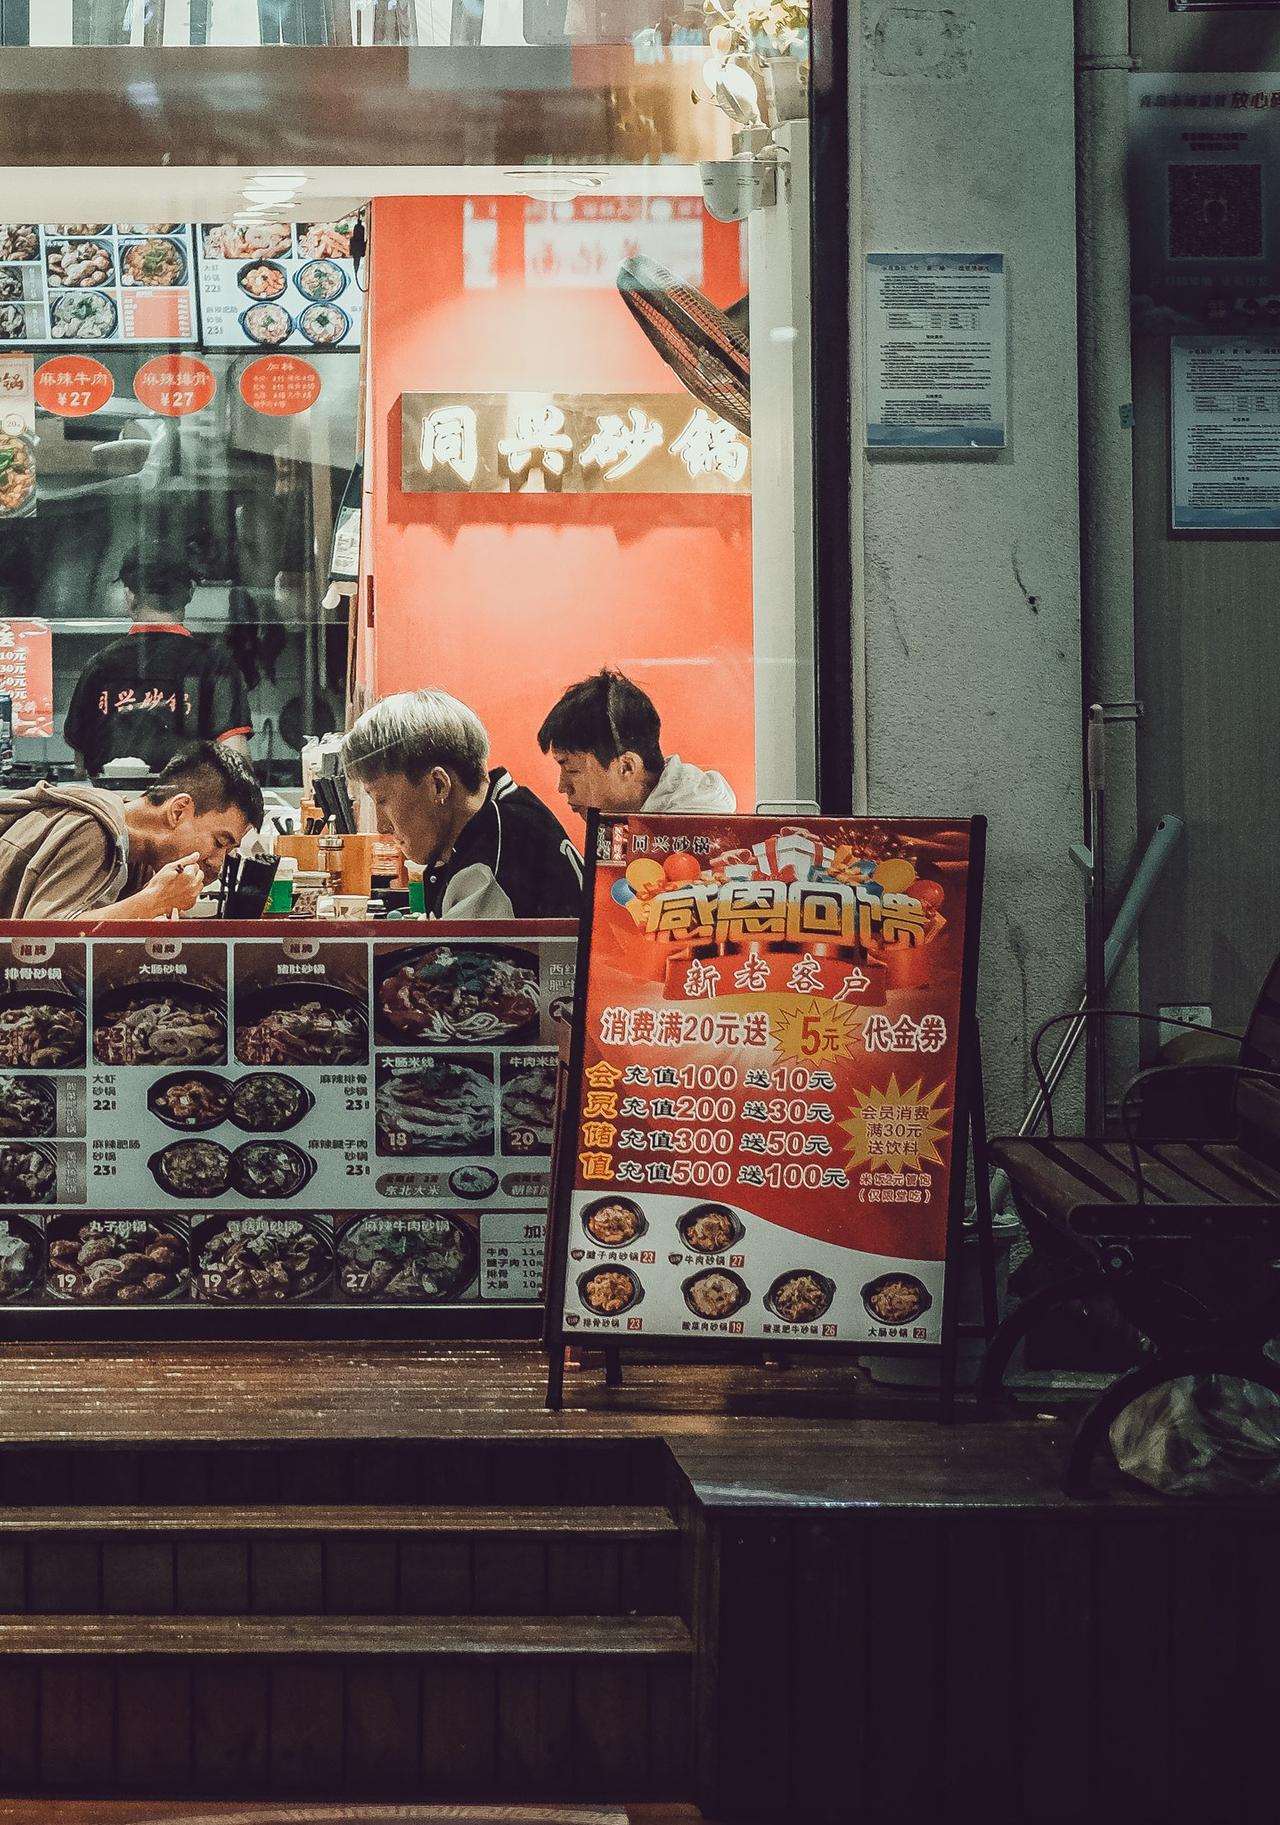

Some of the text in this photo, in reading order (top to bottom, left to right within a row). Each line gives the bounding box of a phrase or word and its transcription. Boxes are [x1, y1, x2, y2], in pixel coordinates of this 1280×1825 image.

[39, 372, 108, 387] 麻辣牛肉
[420, 405, 748, 483] 同兴砂锅
[631, 834, 711, 855] 同兴砂锅
[644, 878, 927, 952] 感恩回馈
[20, 944, 47, 956] 招牌
[4, 966, 63, 980] 排骨砂锅
[683, 952, 872, 1002] 新老客户
[599, 1006, 948, 1056] 消费满20元送 5元 代金券
[381, 1056, 435, 1068] 大肠米线
[622, 1063, 837, 1092] 充值100 送10元
[620, 1095, 835, 1125] 充值200 送30元
[861, 1105, 930, 1121] 会员消费
[578, 1059, 622, 1181] 会员储值
[866, 1123, 922, 1138] 满30元
[387, 1132, 408, 1147] 18
[511, 1131, 534, 1146] 20
[619, 1127, 833, 1157] 充值300 送50元
[868, 1140, 919, 1156] 送饮料
[615, 1160, 850, 1190] 充值500 送100元
[384, 1185, 439, 1196] 东北大米
[89, 1220, 147, 1233] 丸子砂锅
[486, 1247, 508, 1257] 牛肉
[641, 1251, 655, 1263] 23
[684, 1254, 743, 1267] 牛肉砂锅 27
[57, 1274, 76, 1288] 19
[202, 1274, 222, 1288] 19
[346, 1273, 368, 1288] 27
[628, 1319, 641, 1330] 23
[731, 1322, 742, 1332] 19
